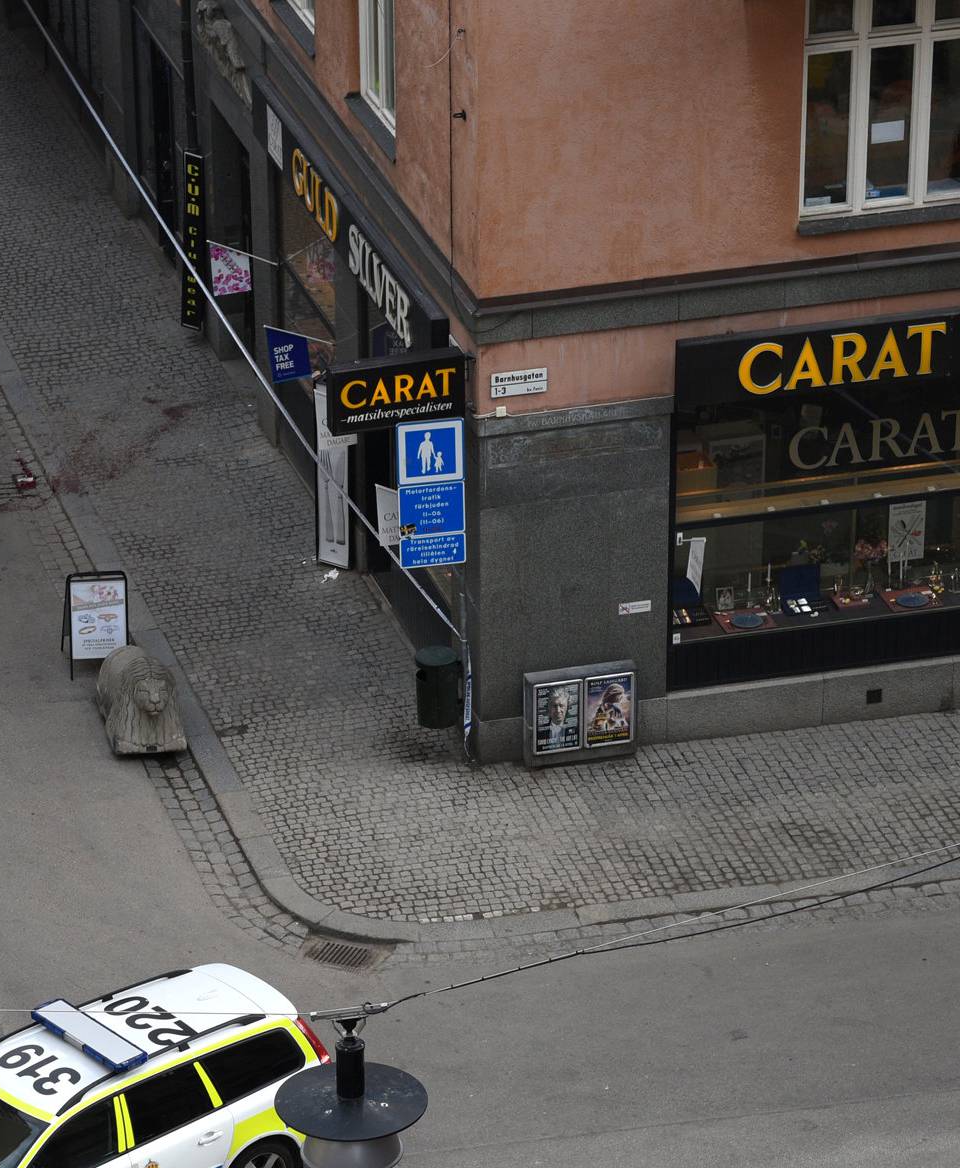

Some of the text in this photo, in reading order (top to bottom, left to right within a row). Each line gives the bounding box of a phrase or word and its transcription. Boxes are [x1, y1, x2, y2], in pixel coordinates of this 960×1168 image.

[292, 148, 338, 242] GULD
[348, 224, 411, 348] SILVER
[273, 343, 294, 355] SHOP
[274, 353, 290, 363] TAX
[738, 321, 947, 395] CARAT
[275, 361, 295, 371] FREE
[494, 372, 544, 383] Barnhusgatan
[340, 368, 457, 409] CARAT
[414, 502, 450, 510] förbjuden
[103, 996, 200, 1046] 220
